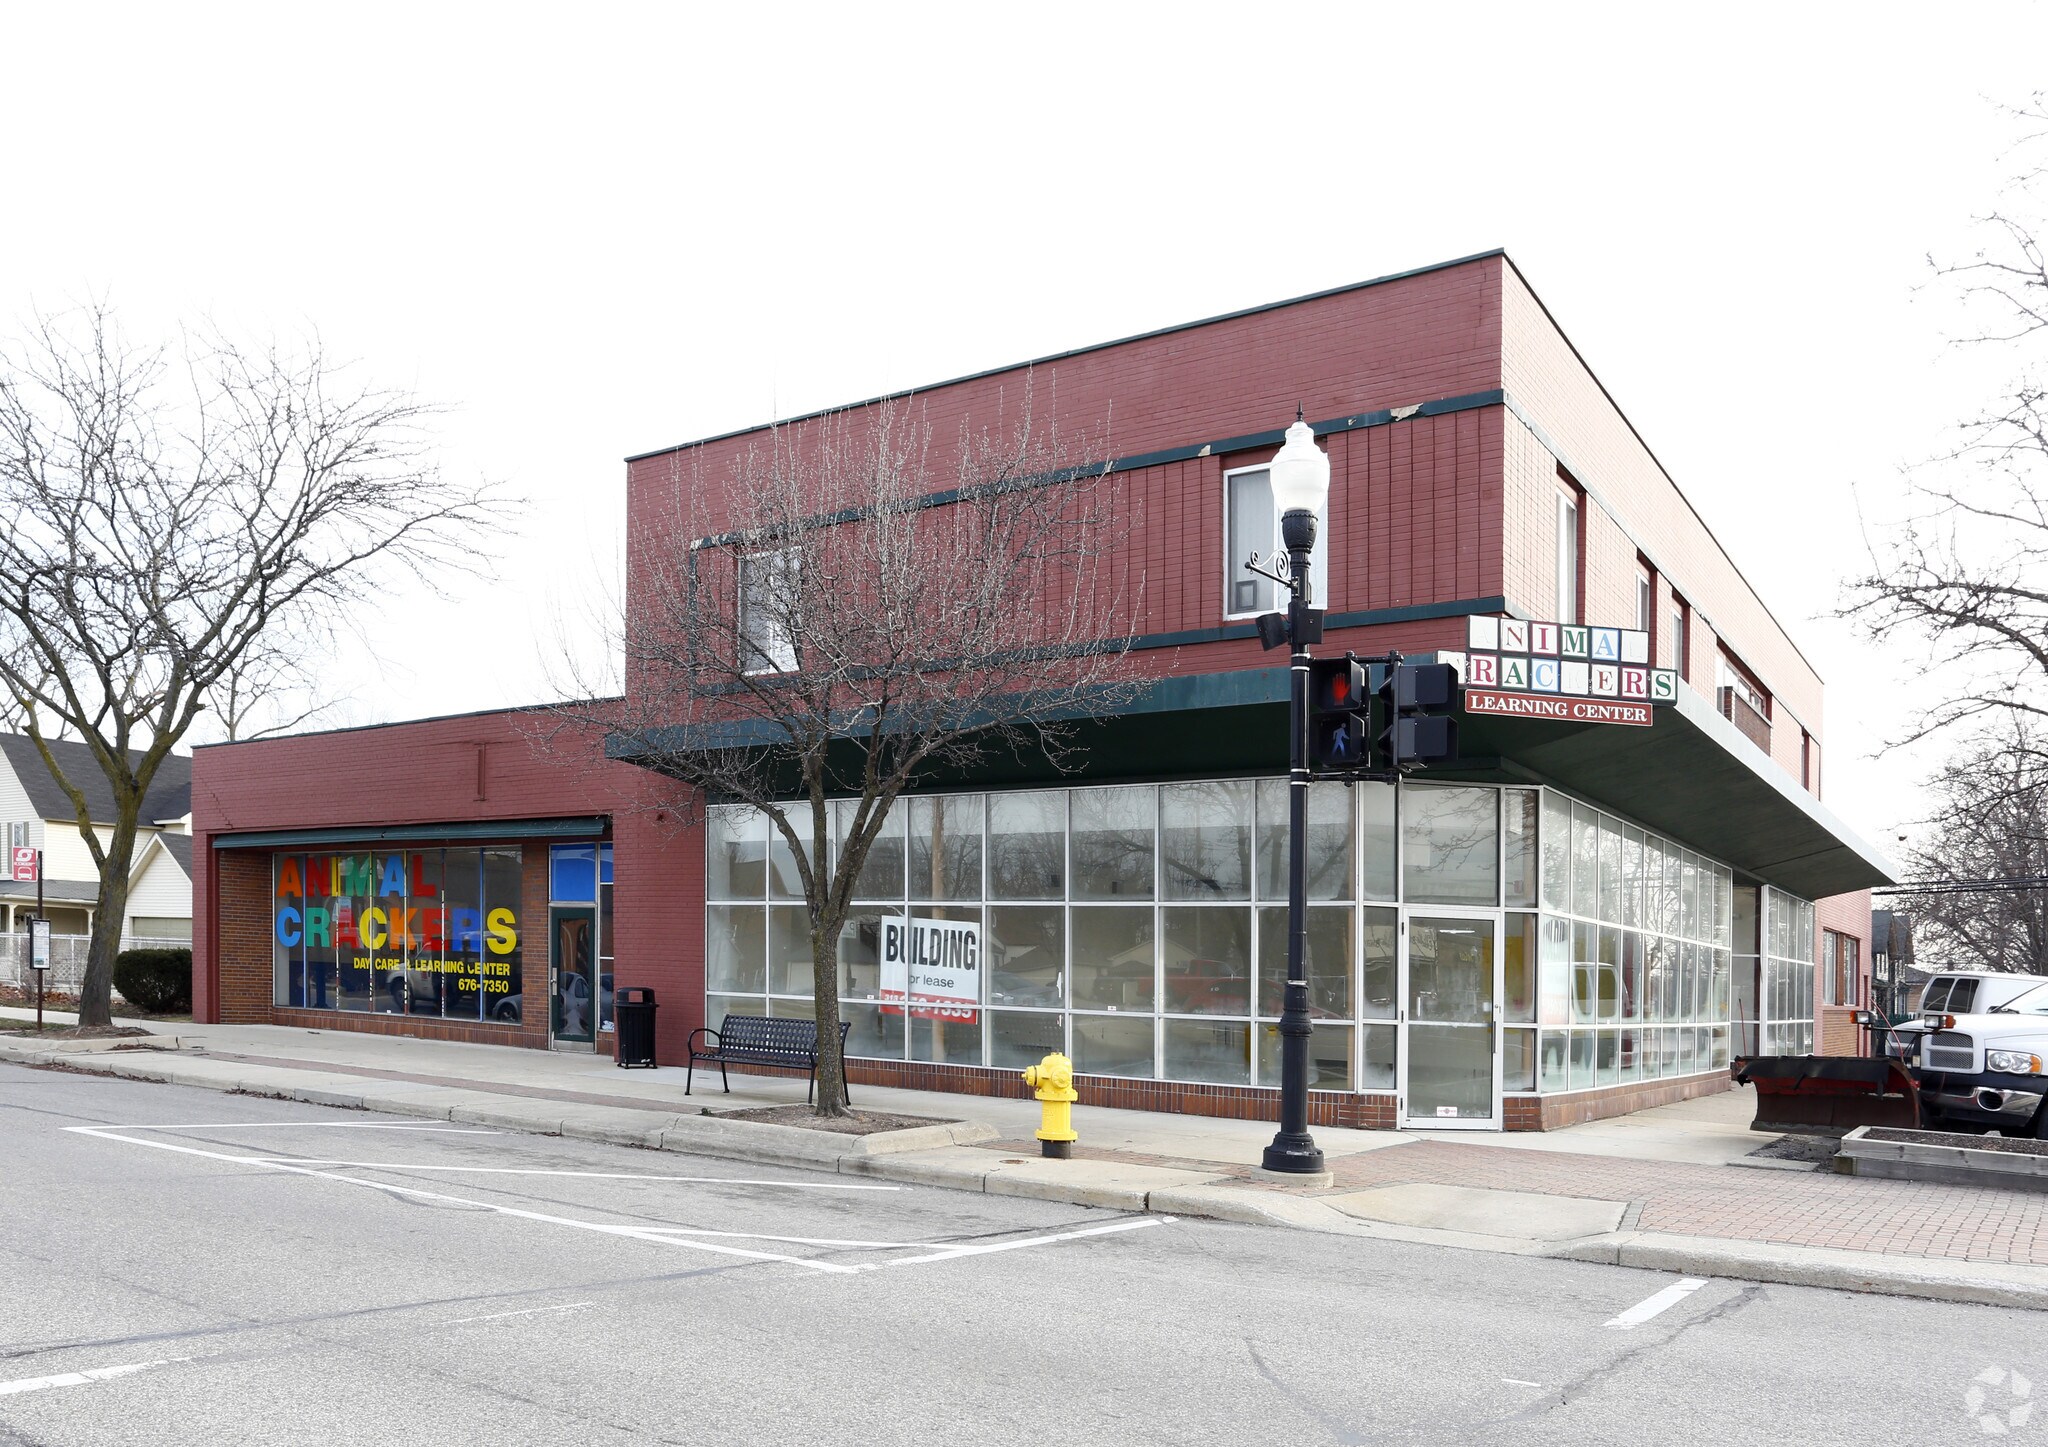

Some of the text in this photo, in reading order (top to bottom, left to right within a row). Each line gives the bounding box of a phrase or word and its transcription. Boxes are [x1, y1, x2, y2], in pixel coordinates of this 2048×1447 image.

[1440, 653, 1672, 697] RACKERS
[1470, 695, 1648, 722] LEARNING CENTER
[276, 854, 436, 897] ANIMAL
[276, 906, 517, 955] CRACKERS
[885, 924, 976, 971] BUILDING
[353, 957, 371, 970] DAY
[374, 958, 400, 971] CARE
[415, 959, 465, 974] LEARNING
[467, 961, 510, 976] CENTER
[907, 974, 955, 988] or lease
[458, 978, 509, 993] 676-7350
